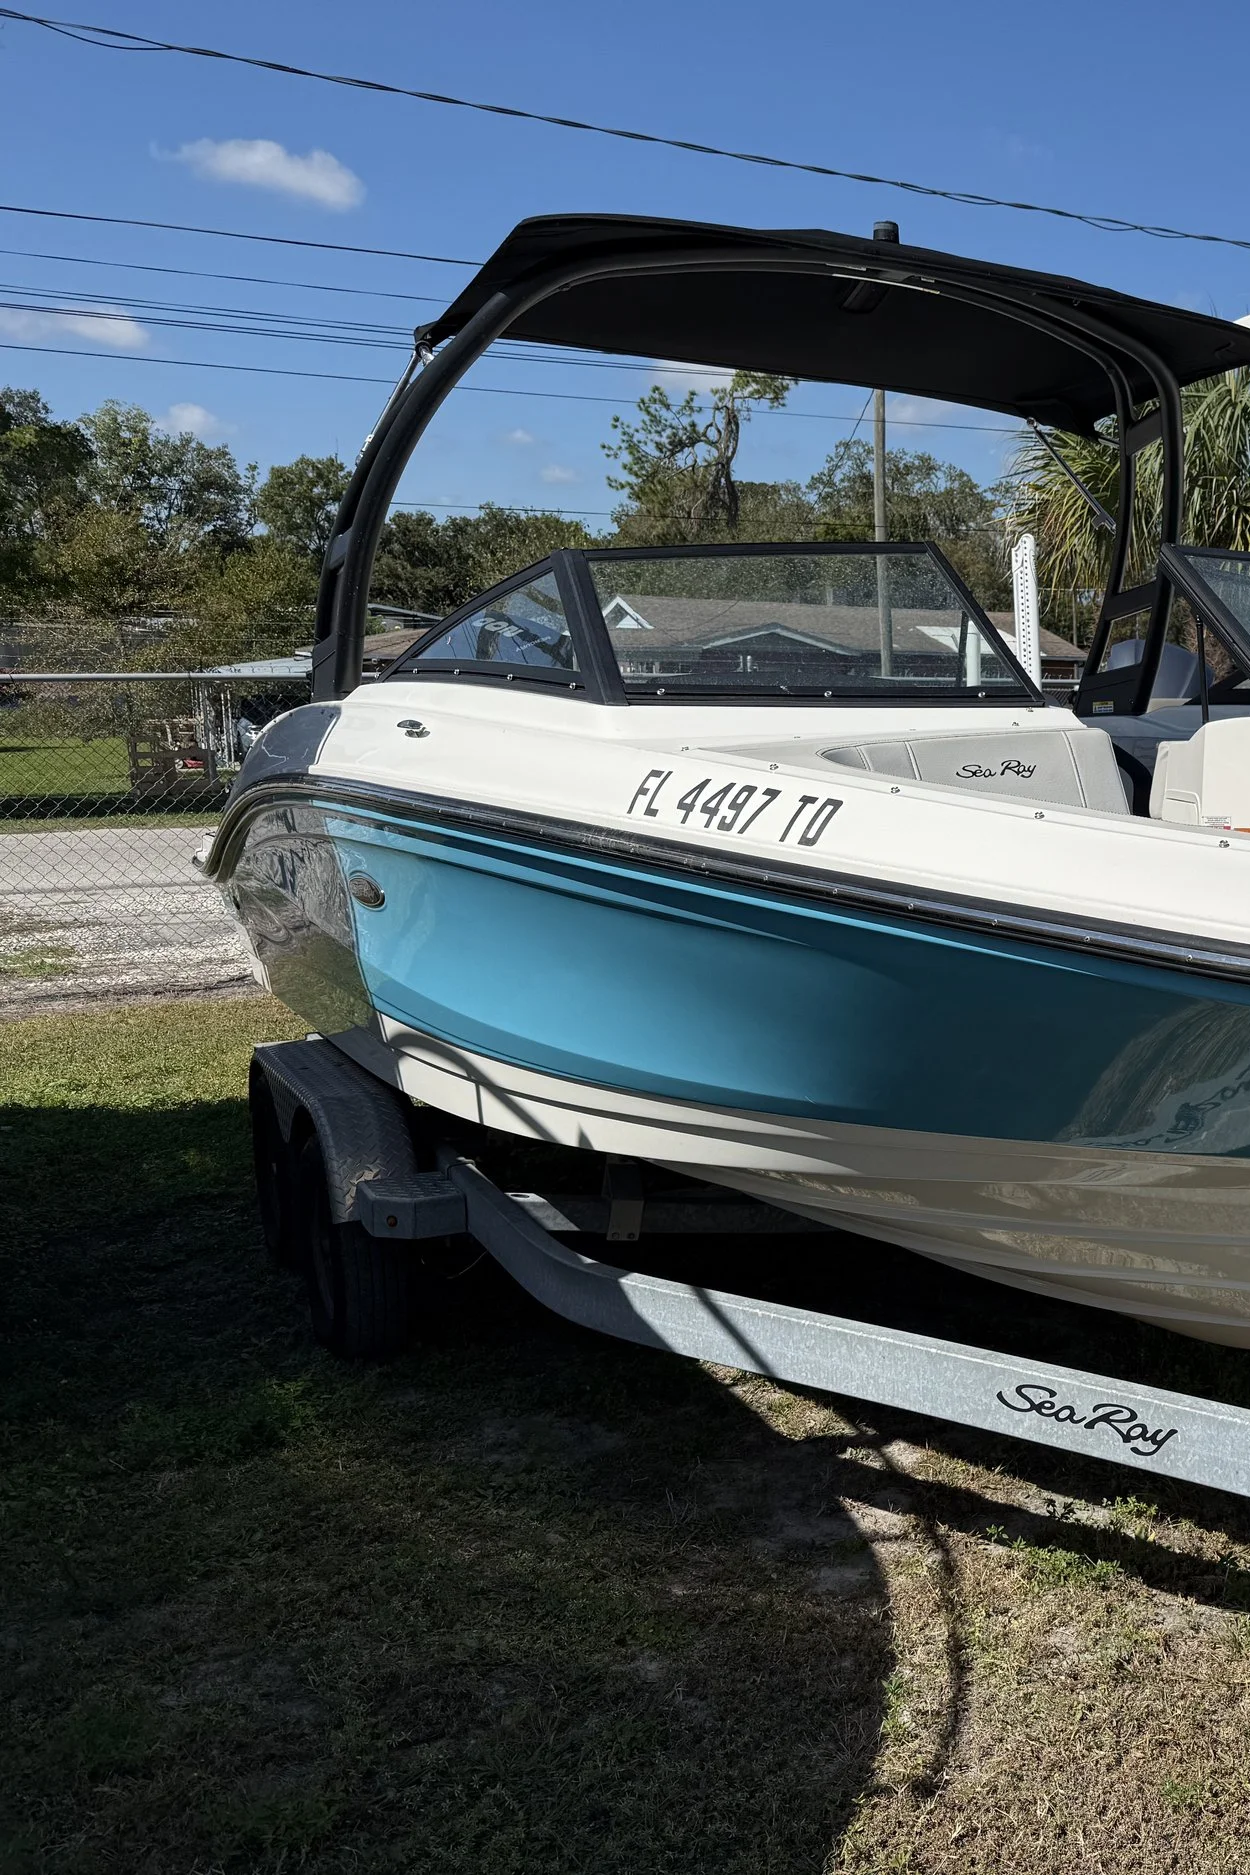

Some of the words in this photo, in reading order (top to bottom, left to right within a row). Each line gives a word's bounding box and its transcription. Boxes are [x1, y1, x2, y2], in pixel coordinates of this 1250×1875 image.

[956, 764, 997, 778] Sea
[1000, 760, 1036, 778] Ray
[626, 769, 673, 817] FL
[676, 778, 782, 834] 4497
[778, 794, 844, 847] TD
[996, 1384, 1087, 1424] Sea
[1084, 1403, 1178, 1456] Ray
